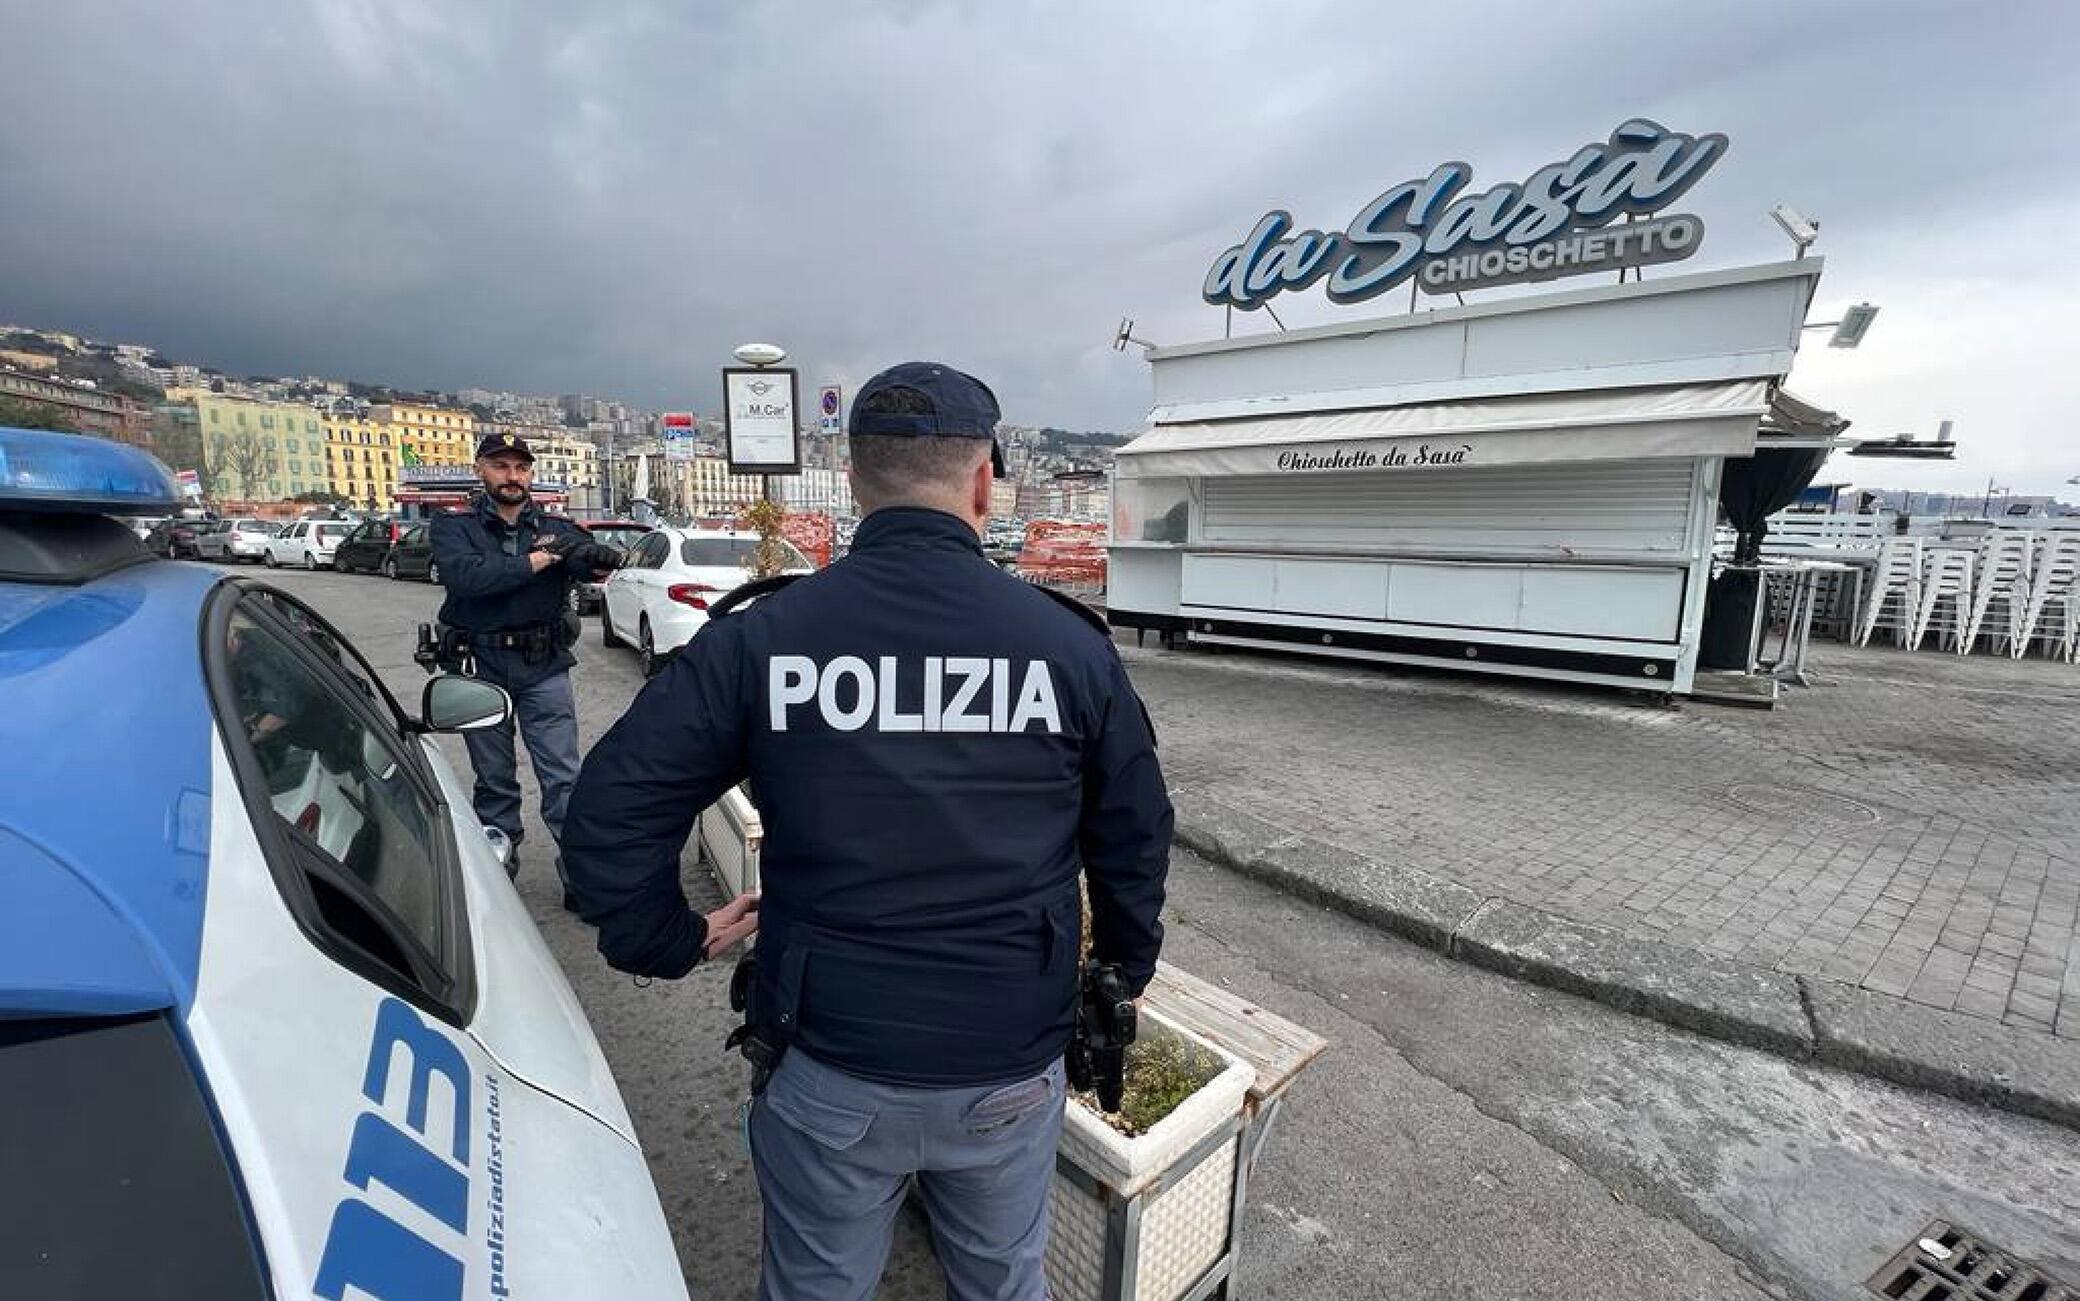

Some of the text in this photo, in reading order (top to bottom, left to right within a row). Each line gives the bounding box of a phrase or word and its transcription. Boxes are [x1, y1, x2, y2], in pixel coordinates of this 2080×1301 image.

[1203, 121, 1711, 301] da Sasà
[1422, 220, 1694, 284] CHIOSCHETTO
[1277, 449, 1377, 471] Chioschetto
[1382, 445, 1407, 467] da
[768, 655, 1062, 732] POLIZIA
[312, 997, 472, 1301] 113
